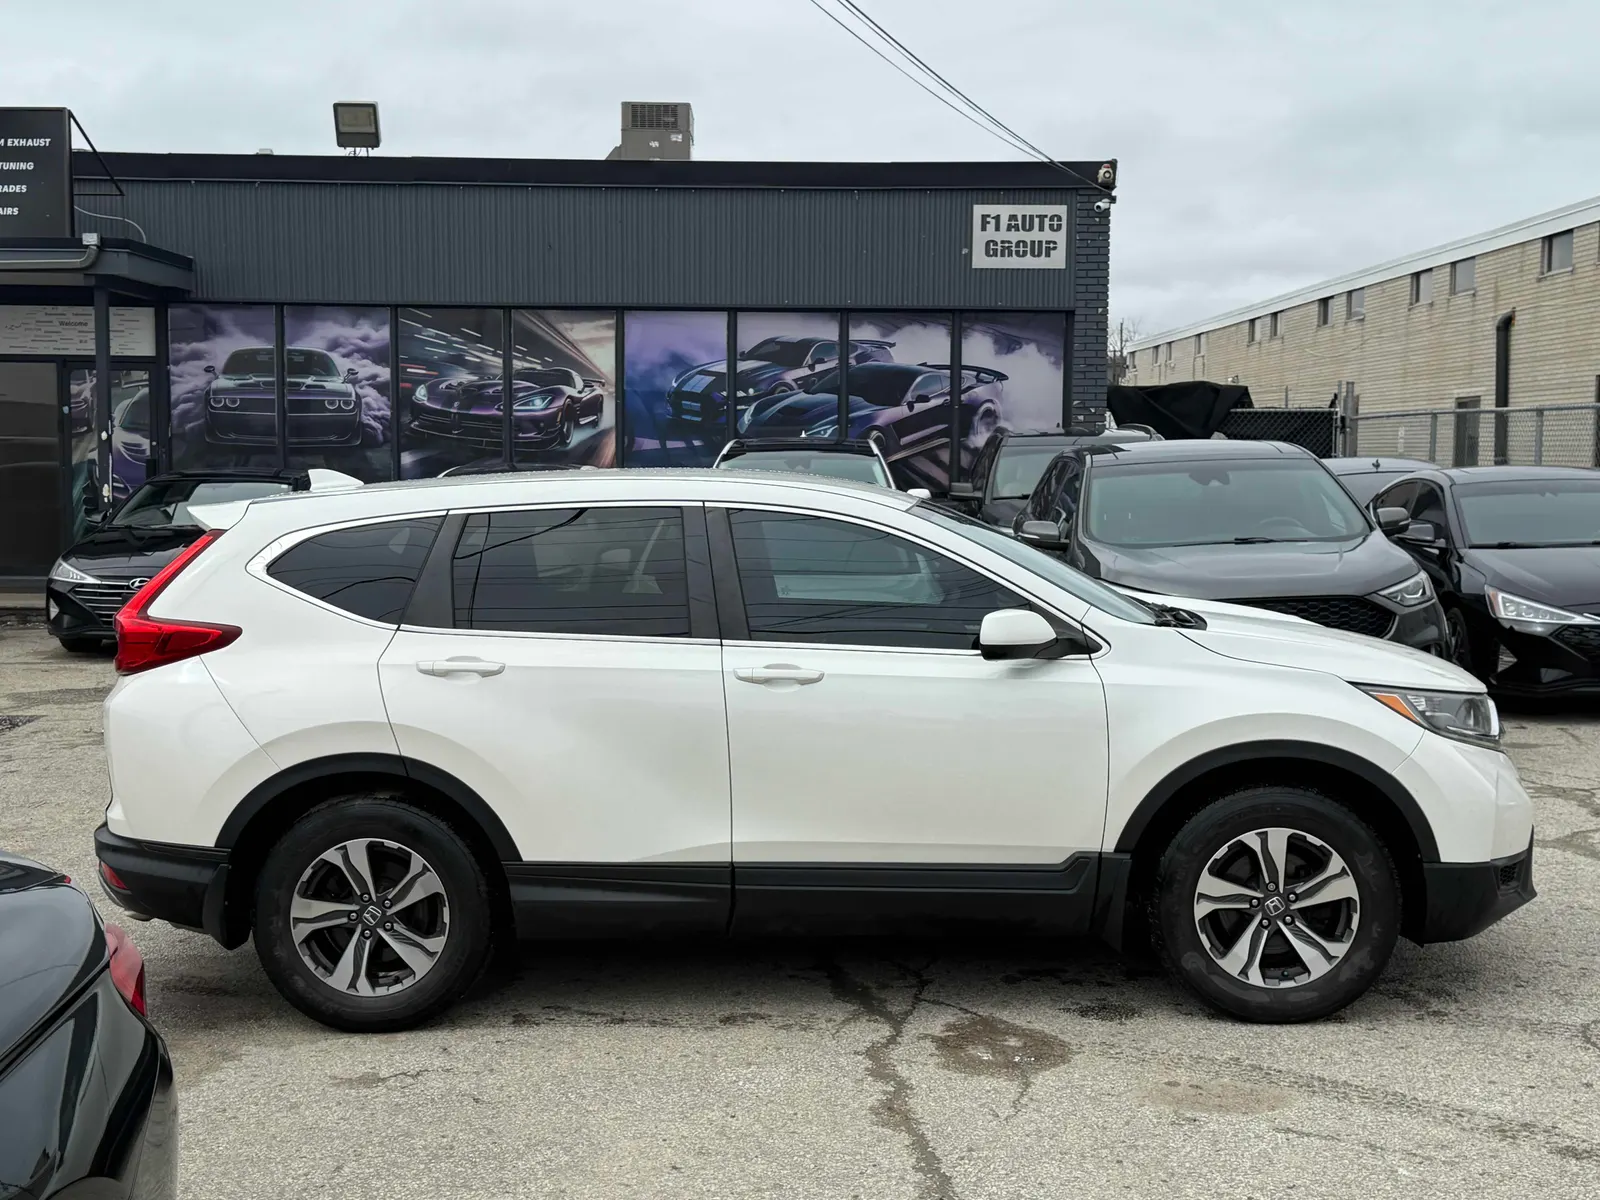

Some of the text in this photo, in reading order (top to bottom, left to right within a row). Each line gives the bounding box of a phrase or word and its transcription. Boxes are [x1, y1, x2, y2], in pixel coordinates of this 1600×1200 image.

[7, 138, 51, 146] EXHAUST
[0, 162, 35, 170] TUNING
[980, 214, 1063, 232] F1 AUTO
[984, 239, 1058, 258] GROUP
